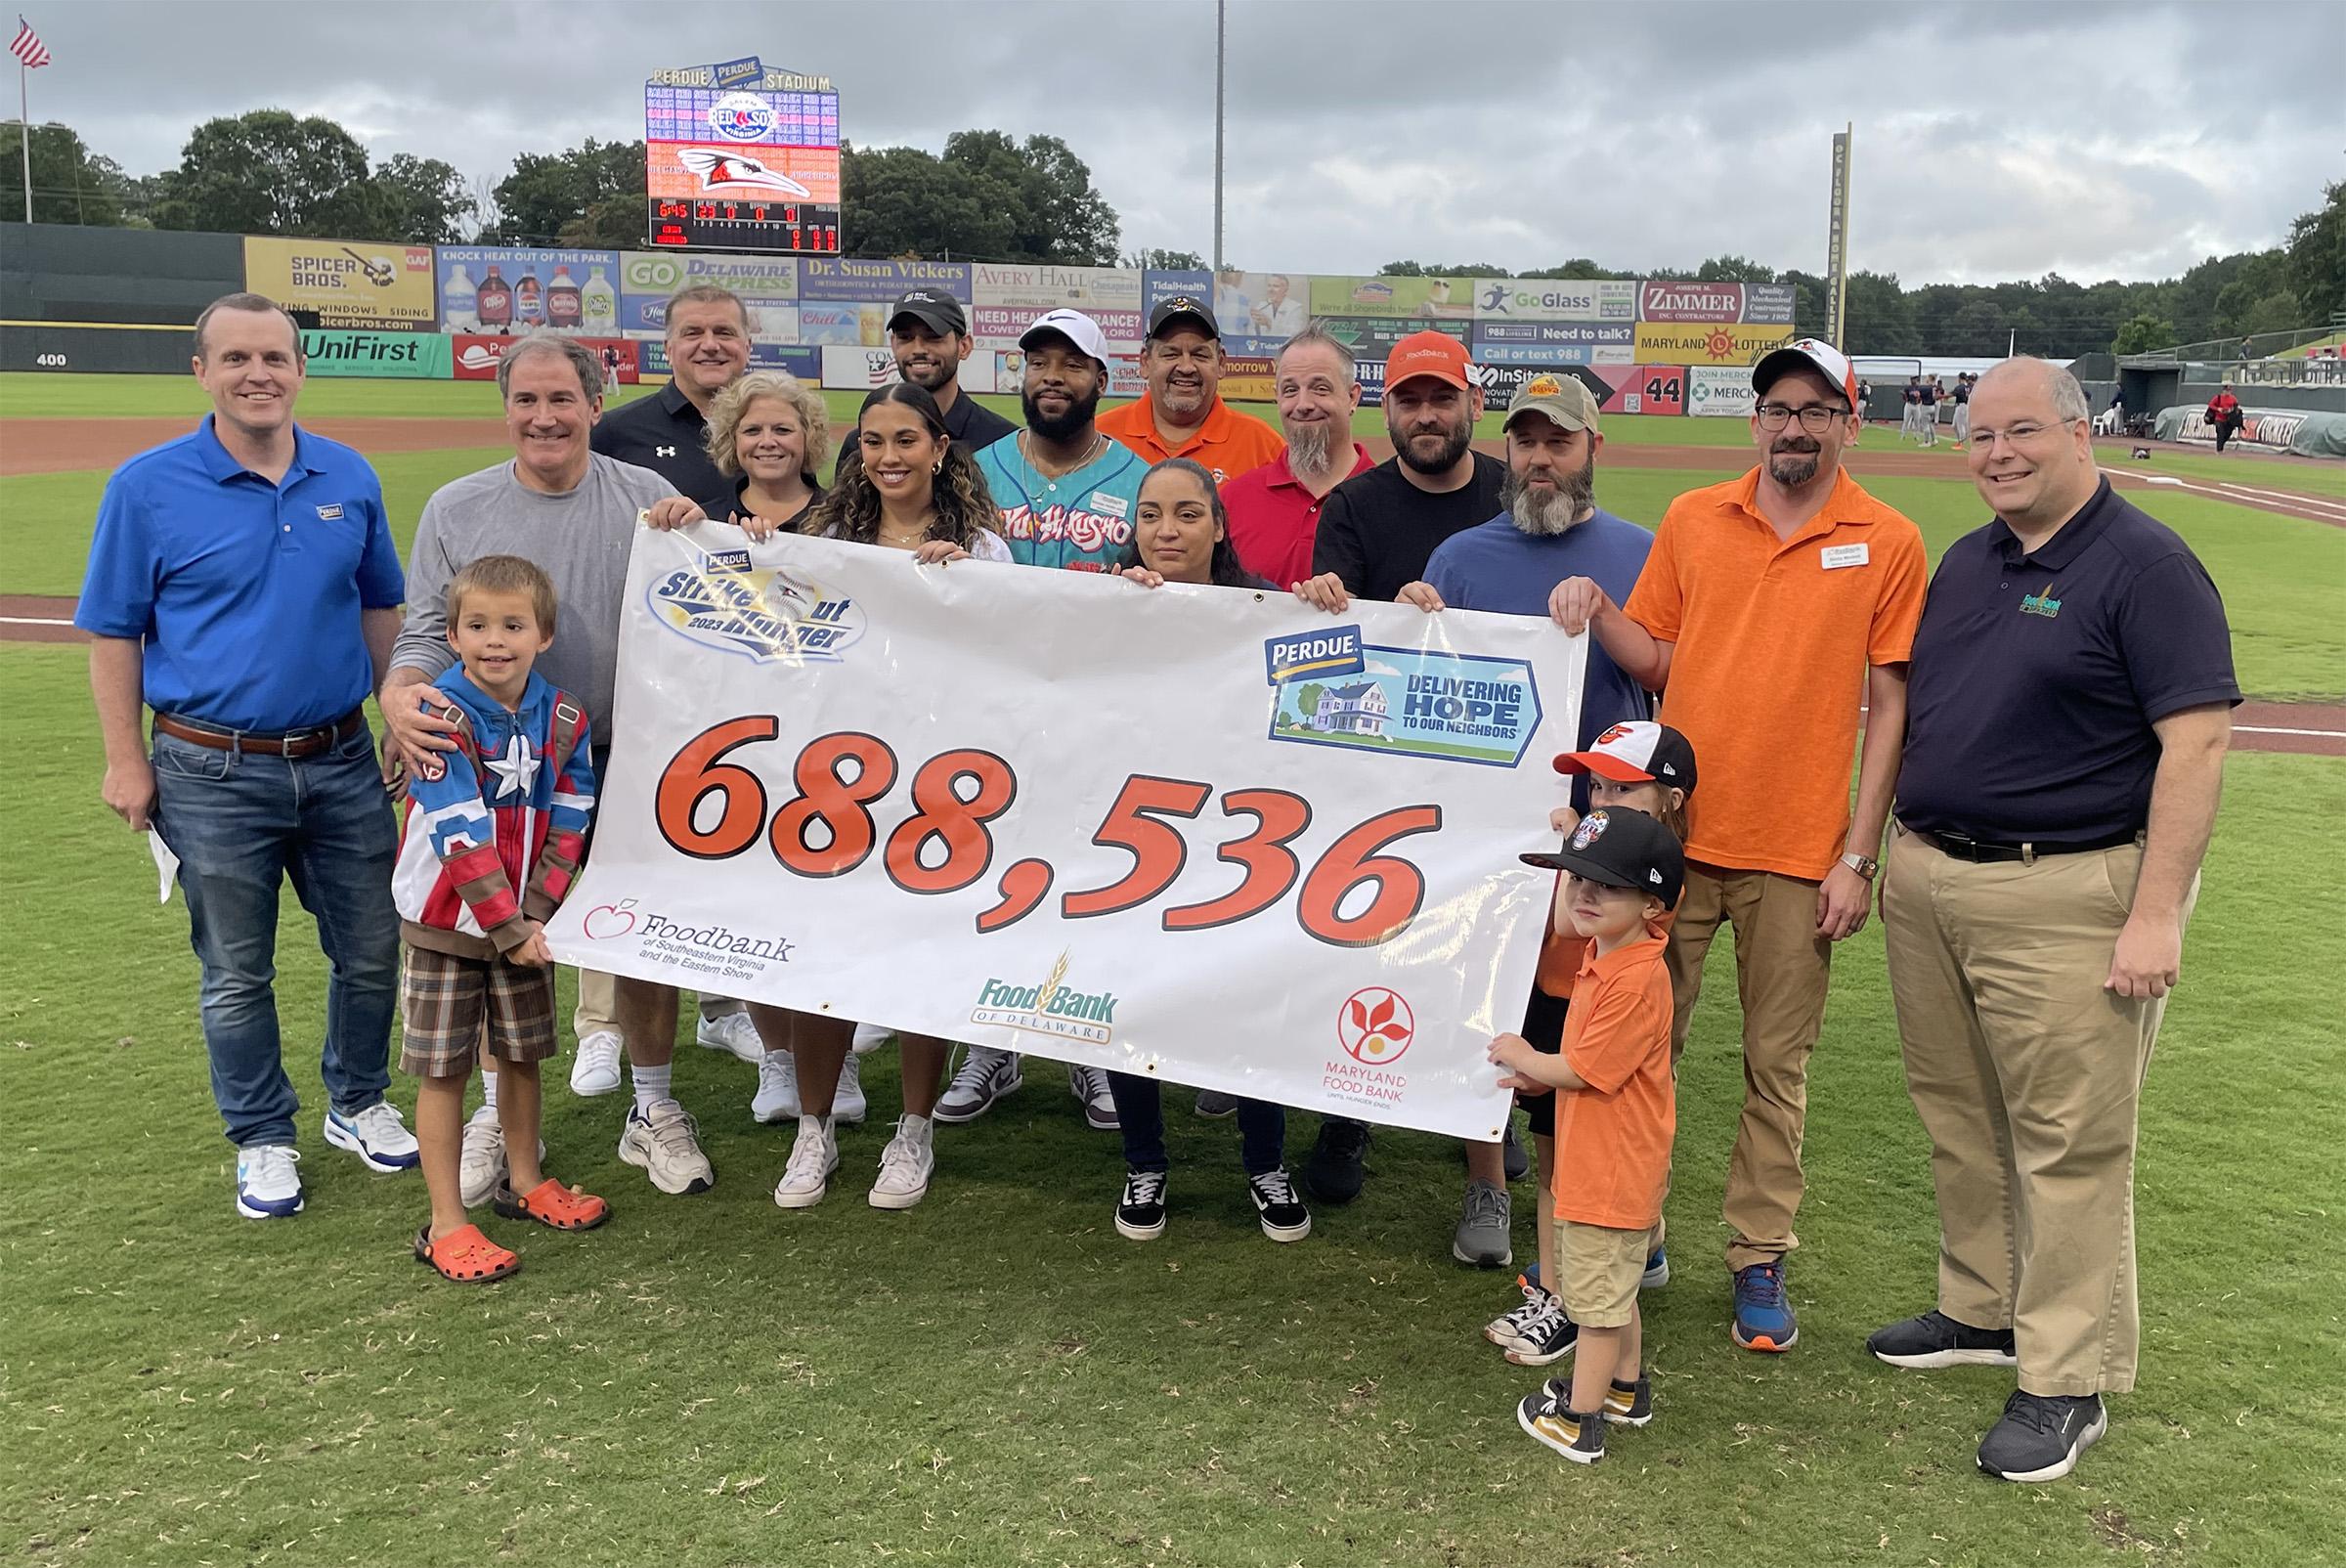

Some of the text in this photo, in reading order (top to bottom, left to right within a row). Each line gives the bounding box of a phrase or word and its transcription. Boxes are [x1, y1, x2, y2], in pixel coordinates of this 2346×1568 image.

[718, 61, 758, 78] PERDUE
[653, 69, 830, 90] PERDUE STADIUM
[659, 203, 687, 218] 6:45
[699, 206, 716, 219] 23
[727, 206, 735, 220] 0
[756, 207, 764, 221] 0
[787, 208, 795, 223] 0
[292, 257, 356, 273] SPICER
[407, 255, 430, 266] GAF
[443, 251, 613, 264] KNOCK HEAT OUT OF THE PARK.
[630, 261, 675, 285] GO
[686, 259, 791, 277] DELAWARE
[808, 259, 964, 280] Dr. Susan Vickers
[976, 266, 1087, 287] AVERY HALL
[293, 273, 347, 288] BROS.
[688, 276, 792, 290] EXPRESS
[1151, 281, 1206, 291] TidalHealth
[1515, 292, 1590, 309] GoGlass
[1648, 287, 1736, 311] ZIMMER
[318, 305, 428, 317] WINDOWS SIDING
[803, 312, 837, 326] Chill
[976, 310, 1009, 324] NEED
[1488, 327, 1505, 337] 988
[1542, 327, 1630, 340] Need to talk?
[303, 335, 419, 362] UniFirst
[1641, 338, 1706, 349] MARYLAND
[1735, 339, 1786, 350] LOTTERY
[36, 354, 66, 367] 400
[1484, 348, 1581, 360] Call or text 988
[1645, 377, 1680, 403] 44
[1714, 387, 1756, 399] MERCK
[709, 553, 748, 566] PERDUE
[658, 572, 760, 607] Strike
[687, 608, 847, 650] 2023 Hunger
[1408, 675, 1521, 704] DELIVERING
[1404, 694, 1520, 726] HOPE
[1403, 717, 1517, 739] TO OUR NEIGHBORS
[654, 714, 1443, 948] 688,536
[636, 914, 796, 963] Foodbank
[643, 937, 765, 972] of Southeastern Virginia
[639, 949, 754, 980] and the Eastern Shore
[978, 978, 1118, 1024] Food Bank
[978, 1013, 1105, 1040] OF DELAWARE
[1325, 1062, 1407, 1088] MARYLAND
[1324, 1076, 1404, 1103] FOOD BANK
[1346, 1095, 1371, 1106] HUNGER
